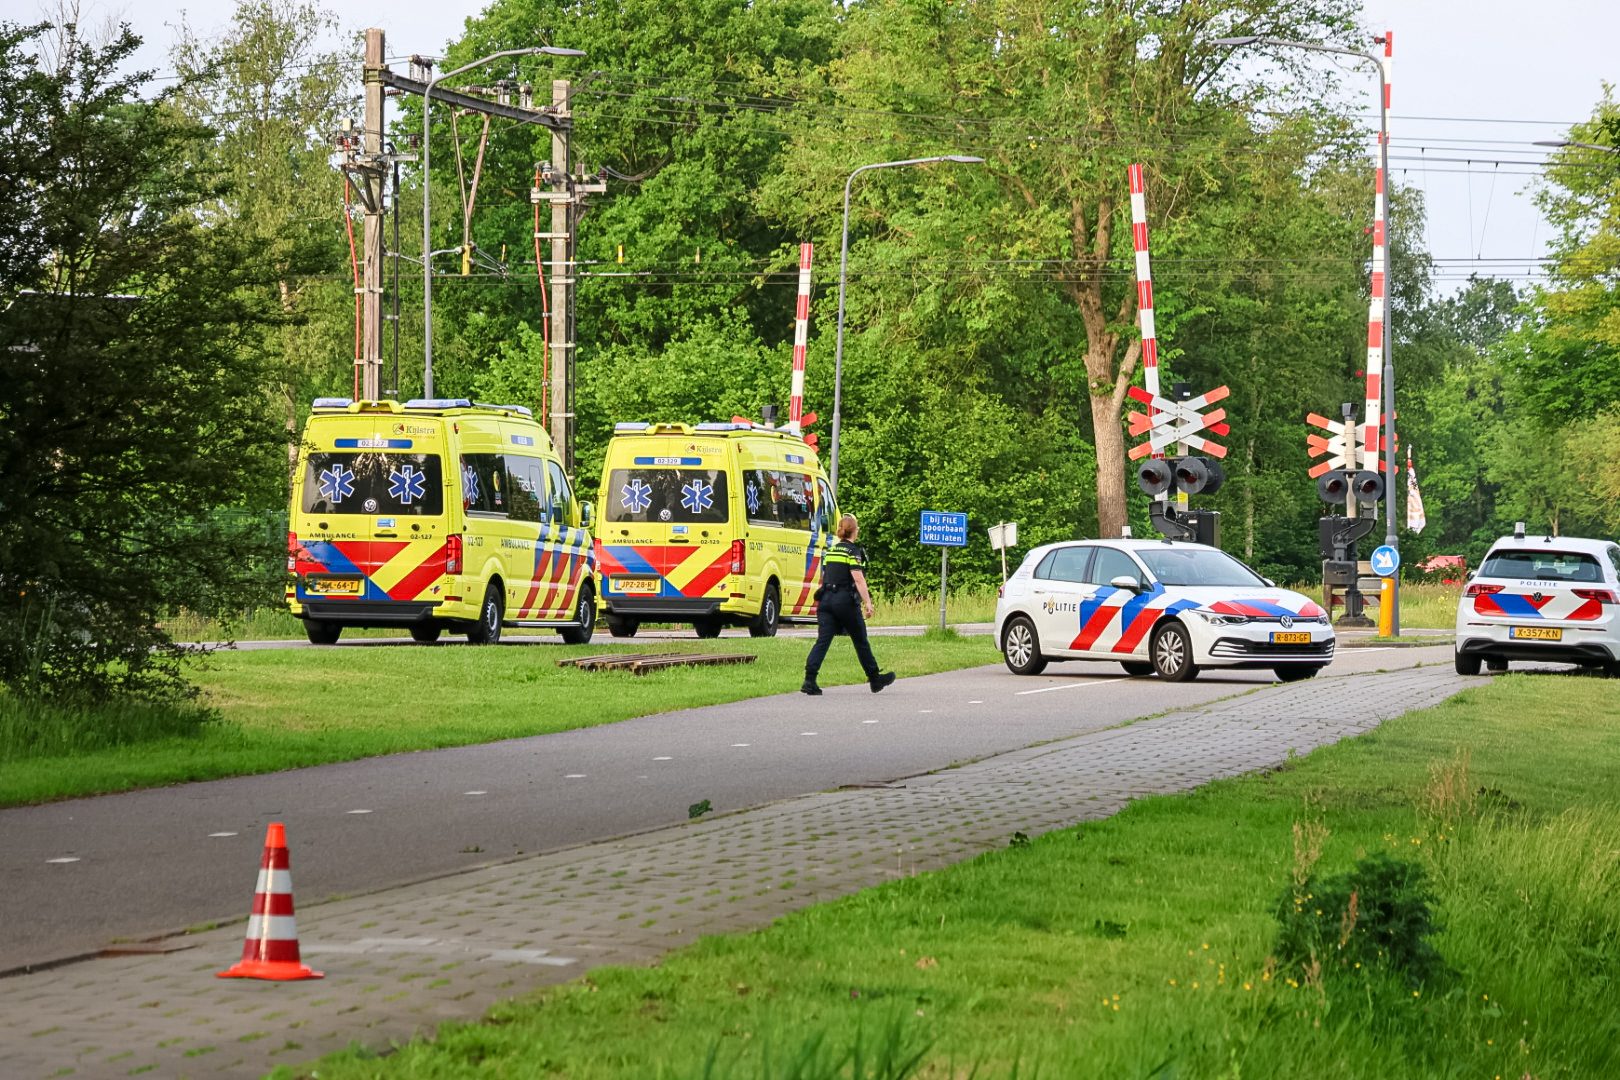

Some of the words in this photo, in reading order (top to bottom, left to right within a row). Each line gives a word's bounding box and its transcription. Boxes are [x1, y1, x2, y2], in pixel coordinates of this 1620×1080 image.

[406, 425, 435, 435] Kijlstra
[929, 515, 940, 525] bij
[942, 516, 957, 524] FILE
[923, 524, 964, 533] spoorbaan
[924, 533, 940, 541] VRIJ
[942, 533, 962, 542] laten
[500, 537, 530, 550] AMBULANCE
[777, 543, 802, 555] AMBULANCE
[621, 580, 652, 589] JPZ-28-R
[1520, 580, 1558, 588] POLITIE
[1043, 601, 1076, 614] POLITIE
[1276, 633, 1308, 641] R-873-GF
[1517, 628, 1558, 638] X-357-KN
